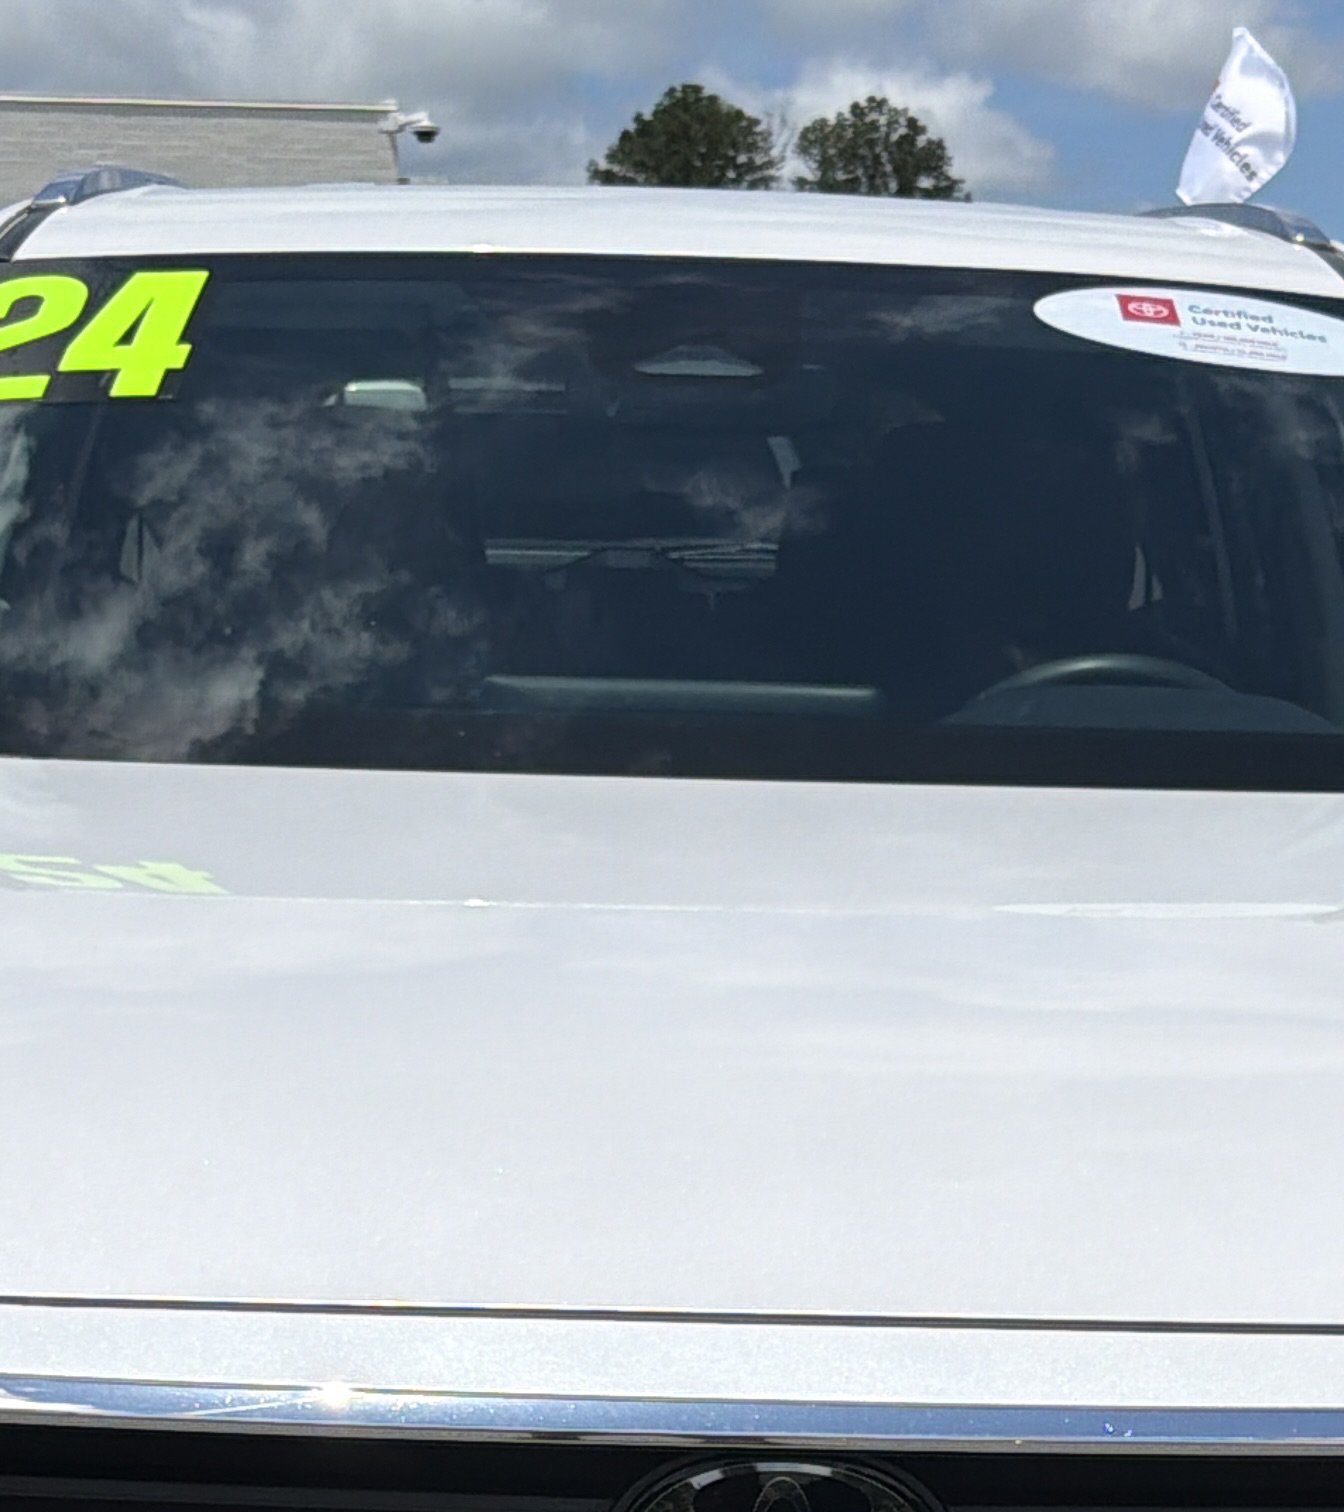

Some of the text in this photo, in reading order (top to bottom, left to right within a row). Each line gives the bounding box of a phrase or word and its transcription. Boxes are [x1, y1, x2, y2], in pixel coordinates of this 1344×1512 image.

[1188, 304, 1274, 324] Certified
[1191, 316, 1242, 331] Used
[1248, 323, 1328, 344] Vehicles
